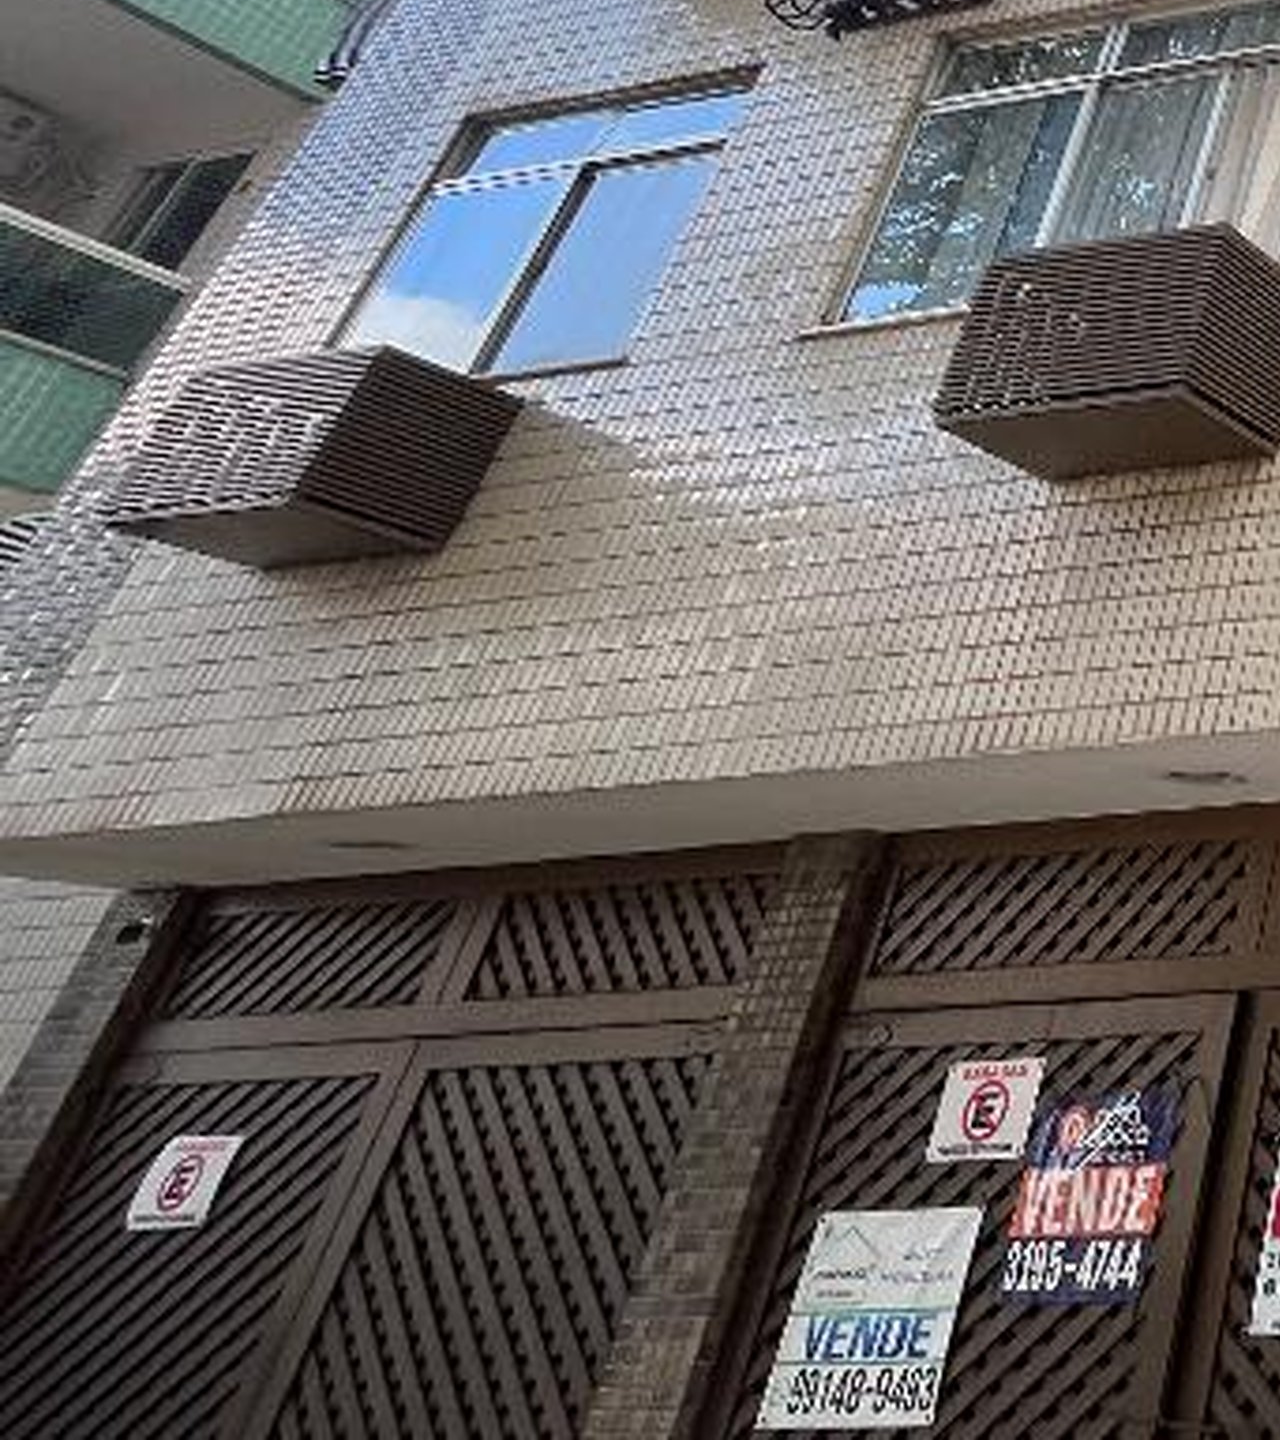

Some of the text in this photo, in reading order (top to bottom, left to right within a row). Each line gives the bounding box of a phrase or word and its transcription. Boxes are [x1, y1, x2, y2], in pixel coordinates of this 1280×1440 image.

[1022, 1167, 1157, 1234] VENDE
[1002, 1239, 1142, 1292] 3195-4744
[806, 1313, 938, 1358] VENDE
